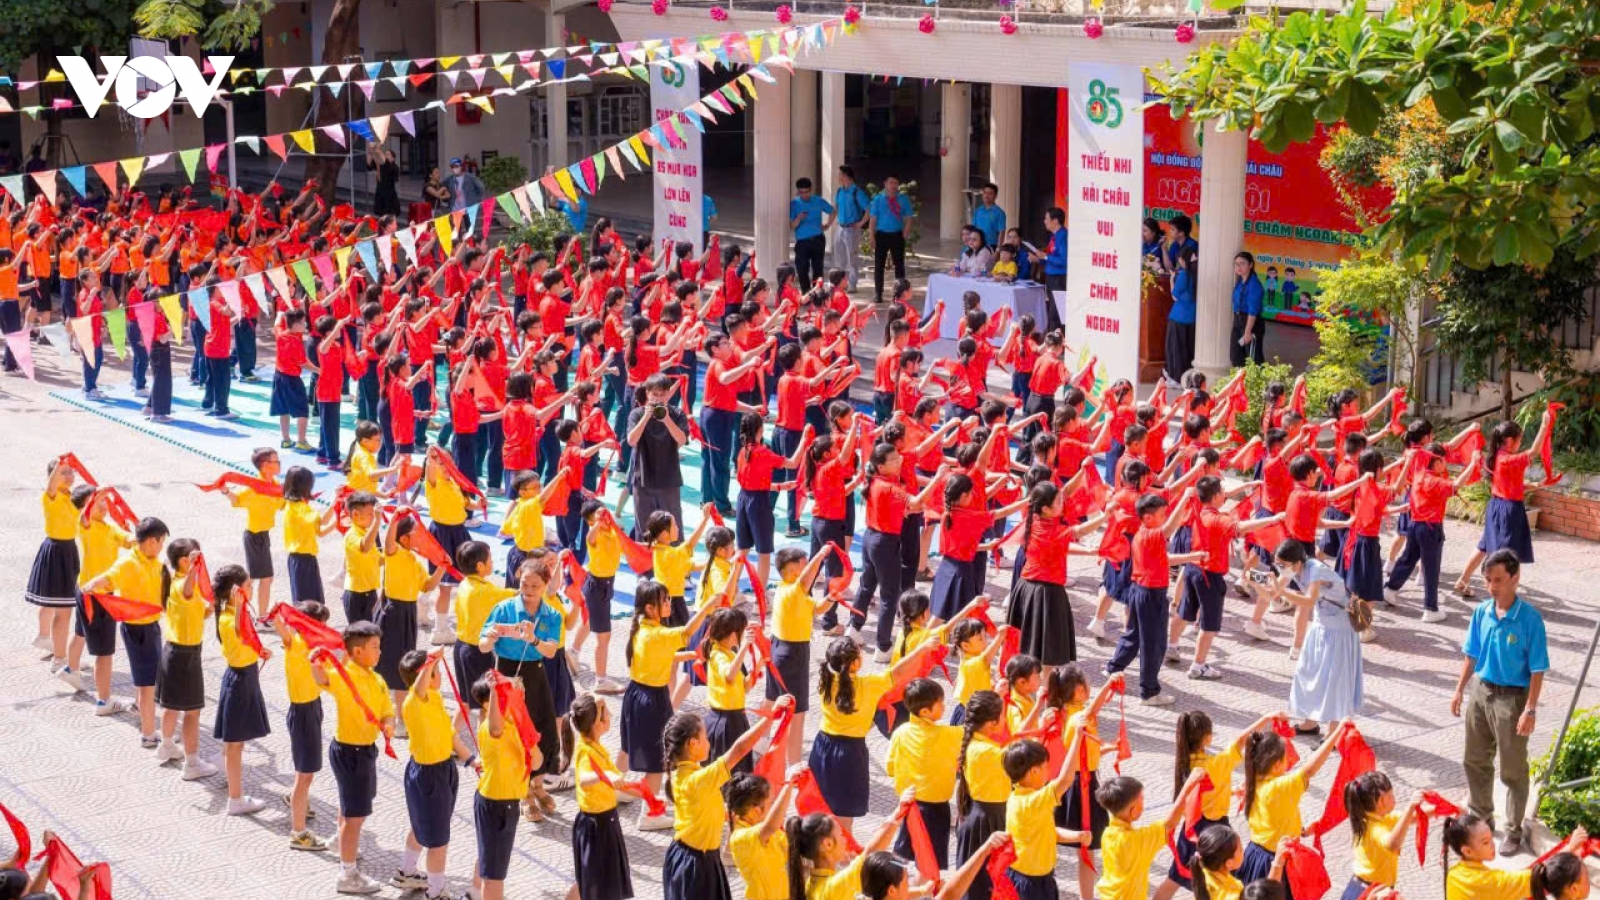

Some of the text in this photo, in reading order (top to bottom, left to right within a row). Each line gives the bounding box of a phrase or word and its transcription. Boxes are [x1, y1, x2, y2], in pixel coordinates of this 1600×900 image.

[1086, 78, 1123, 129] 85
[657, 160, 666, 174] 85
[1081, 150, 1132, 174] THIẾU NHI
[1082, 182, 1130, 206] HẢI CHÂU
[1096, 220, 1114, 237] VUI
[1089, 282, 1118, 301] CHĂM
[1085, 314, 1119, 334] NGOAN
